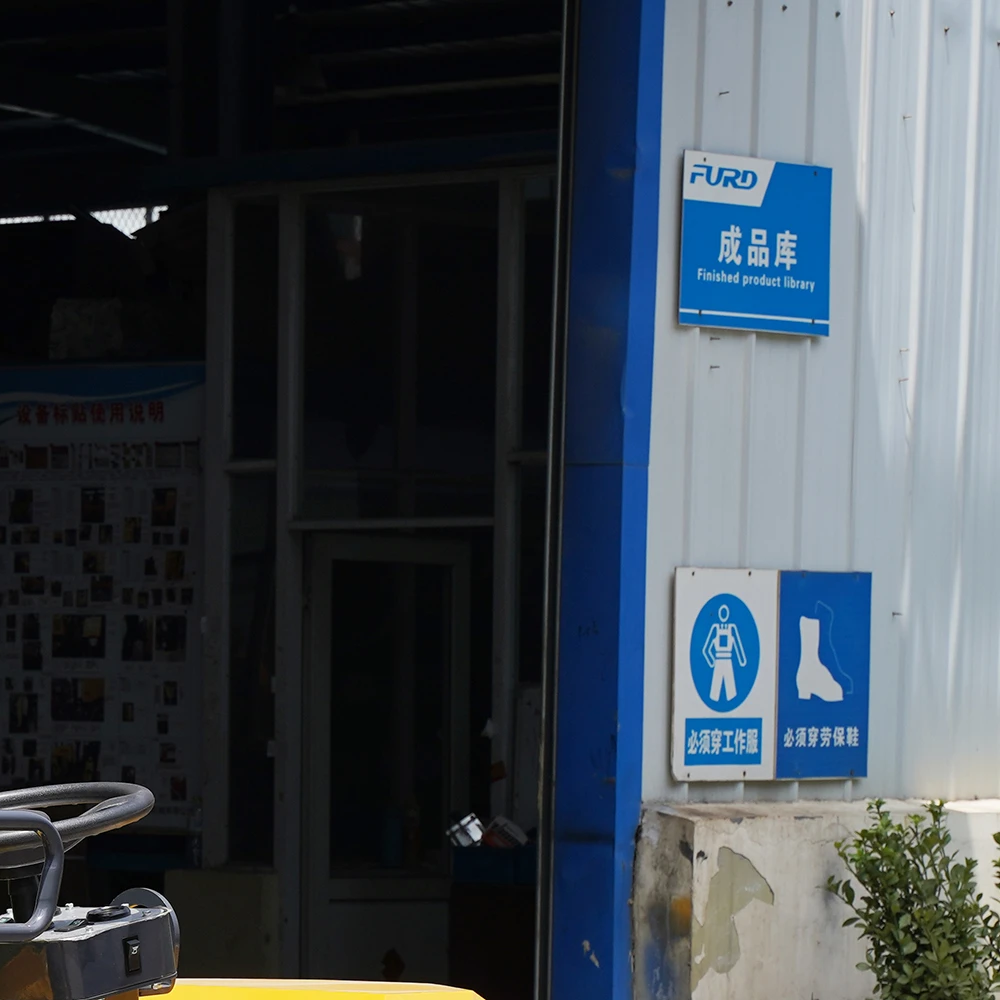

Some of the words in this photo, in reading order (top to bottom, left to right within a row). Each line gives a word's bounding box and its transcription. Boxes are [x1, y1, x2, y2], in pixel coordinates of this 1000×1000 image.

[689, 164, 758, 190] FURD
[717, 224, 798, 271] 成品库
[697, 268, 740, 284] Finished
[742, 274, 781, 287] product
[783, 276, 816, 292] library
[687, 728, 759, 755] 必须穿工作服
[783, 726, 859, 748] 必须穿劳保鞋
